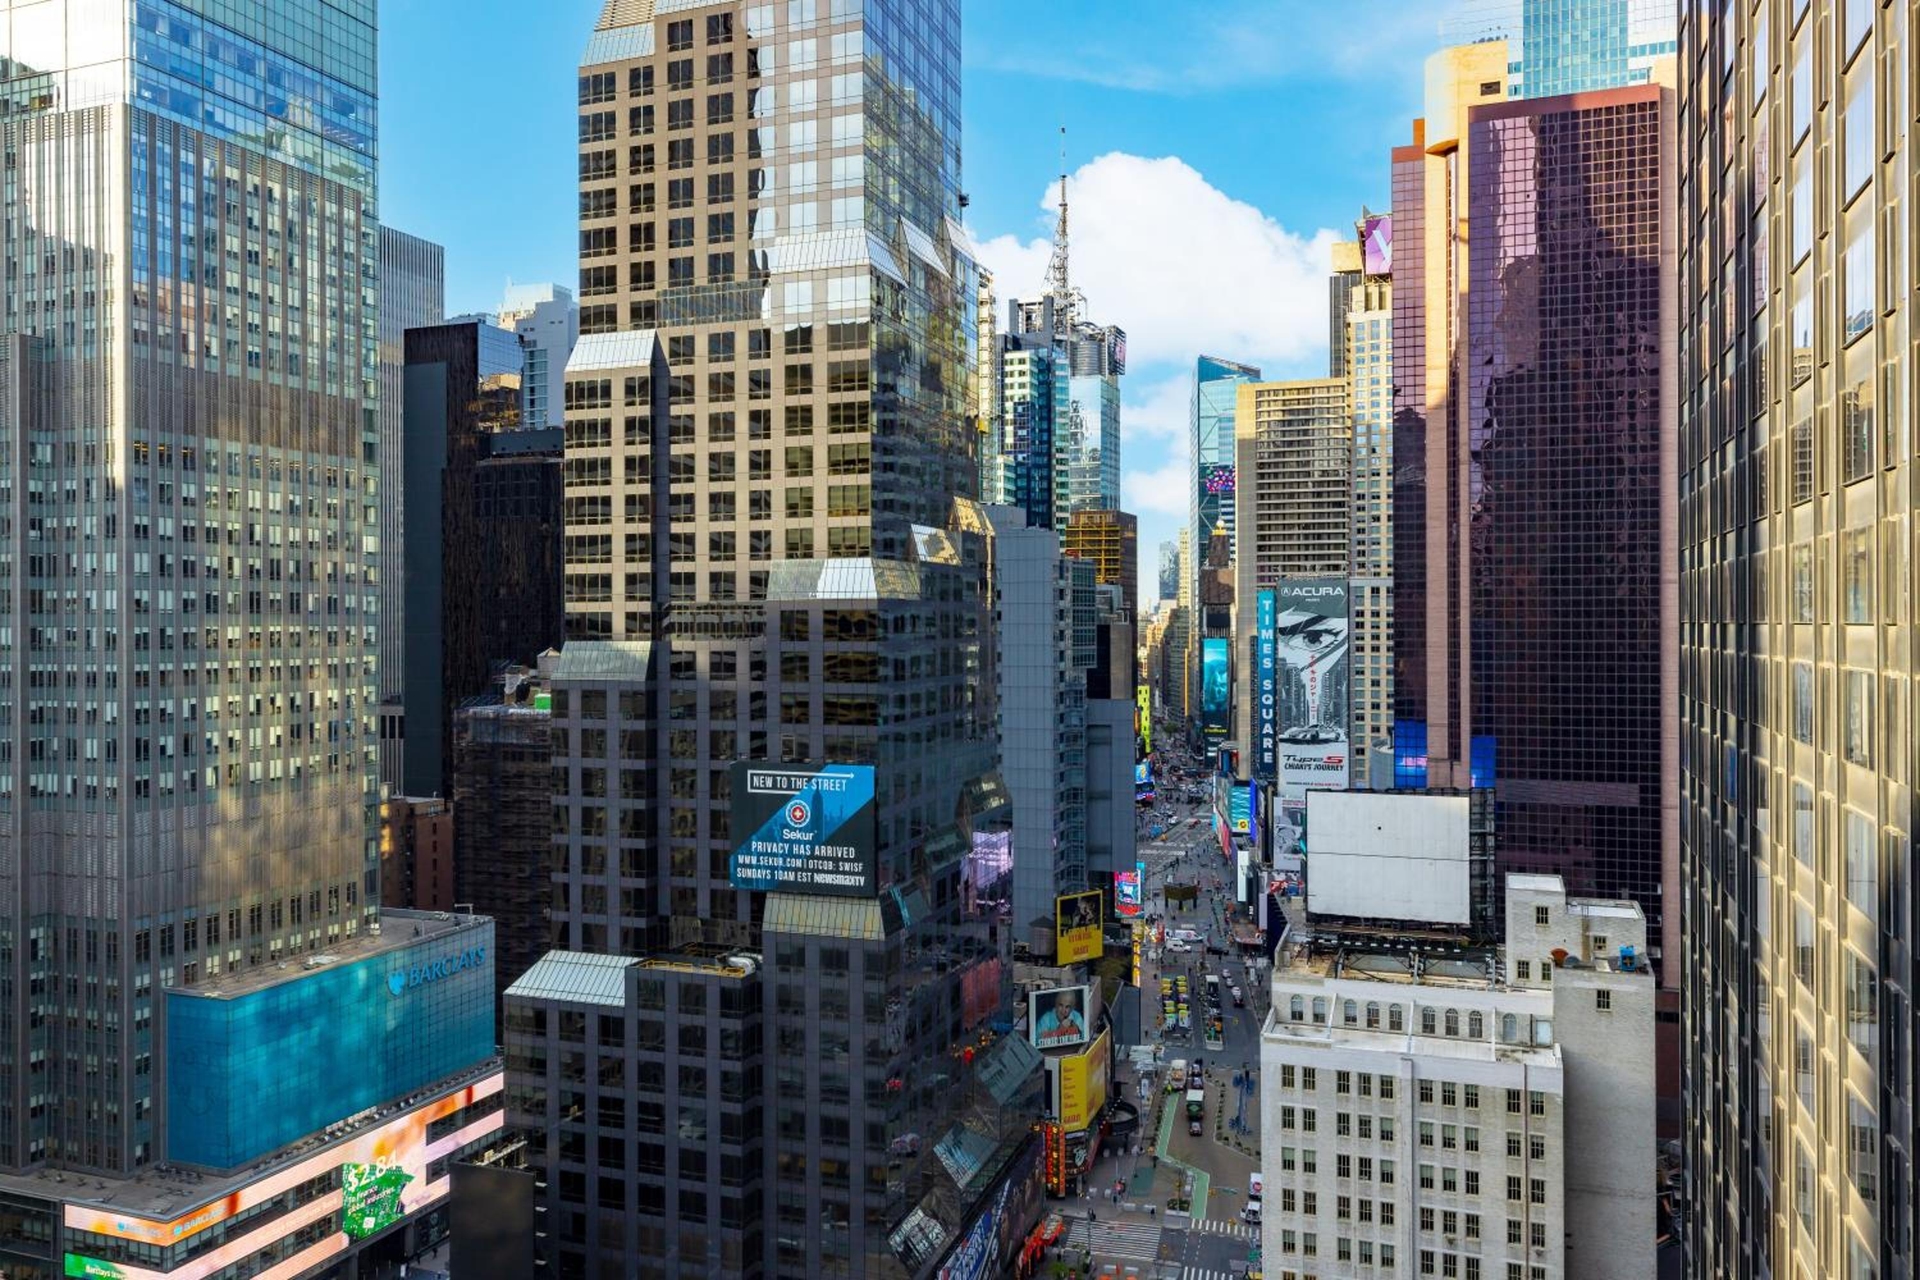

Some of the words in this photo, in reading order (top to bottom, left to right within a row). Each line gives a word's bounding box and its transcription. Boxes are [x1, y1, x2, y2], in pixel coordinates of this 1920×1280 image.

[1291, 586, 1344, 596] ACURA
[1261, 599, 1274, 669] TIMES
[1261, 679, 1274, 763] SQUARE
[1314, 763, 1344, 772] JOURNEY
[753, 775, 773, 788] NEW
[776, 776, 787, 788] TO
[790, 777, 808, 789] THE
[811, 778, 847, 791] STREET
[782, 828, 814, 841] Sekur
[751, 841, 789, 854] PRIVACY
[793, 844, 811, 856] HAS
[814, 845, 855, 859] ARRIVED
[737, 867, 771, 880] SUNDAYS
[774, 870, 795, 882] 10AM
[797, 872, 812, 883] EST
[839, 861, 863, 873] SWISF
[409, 945, 486, 990] BARCLAYS
